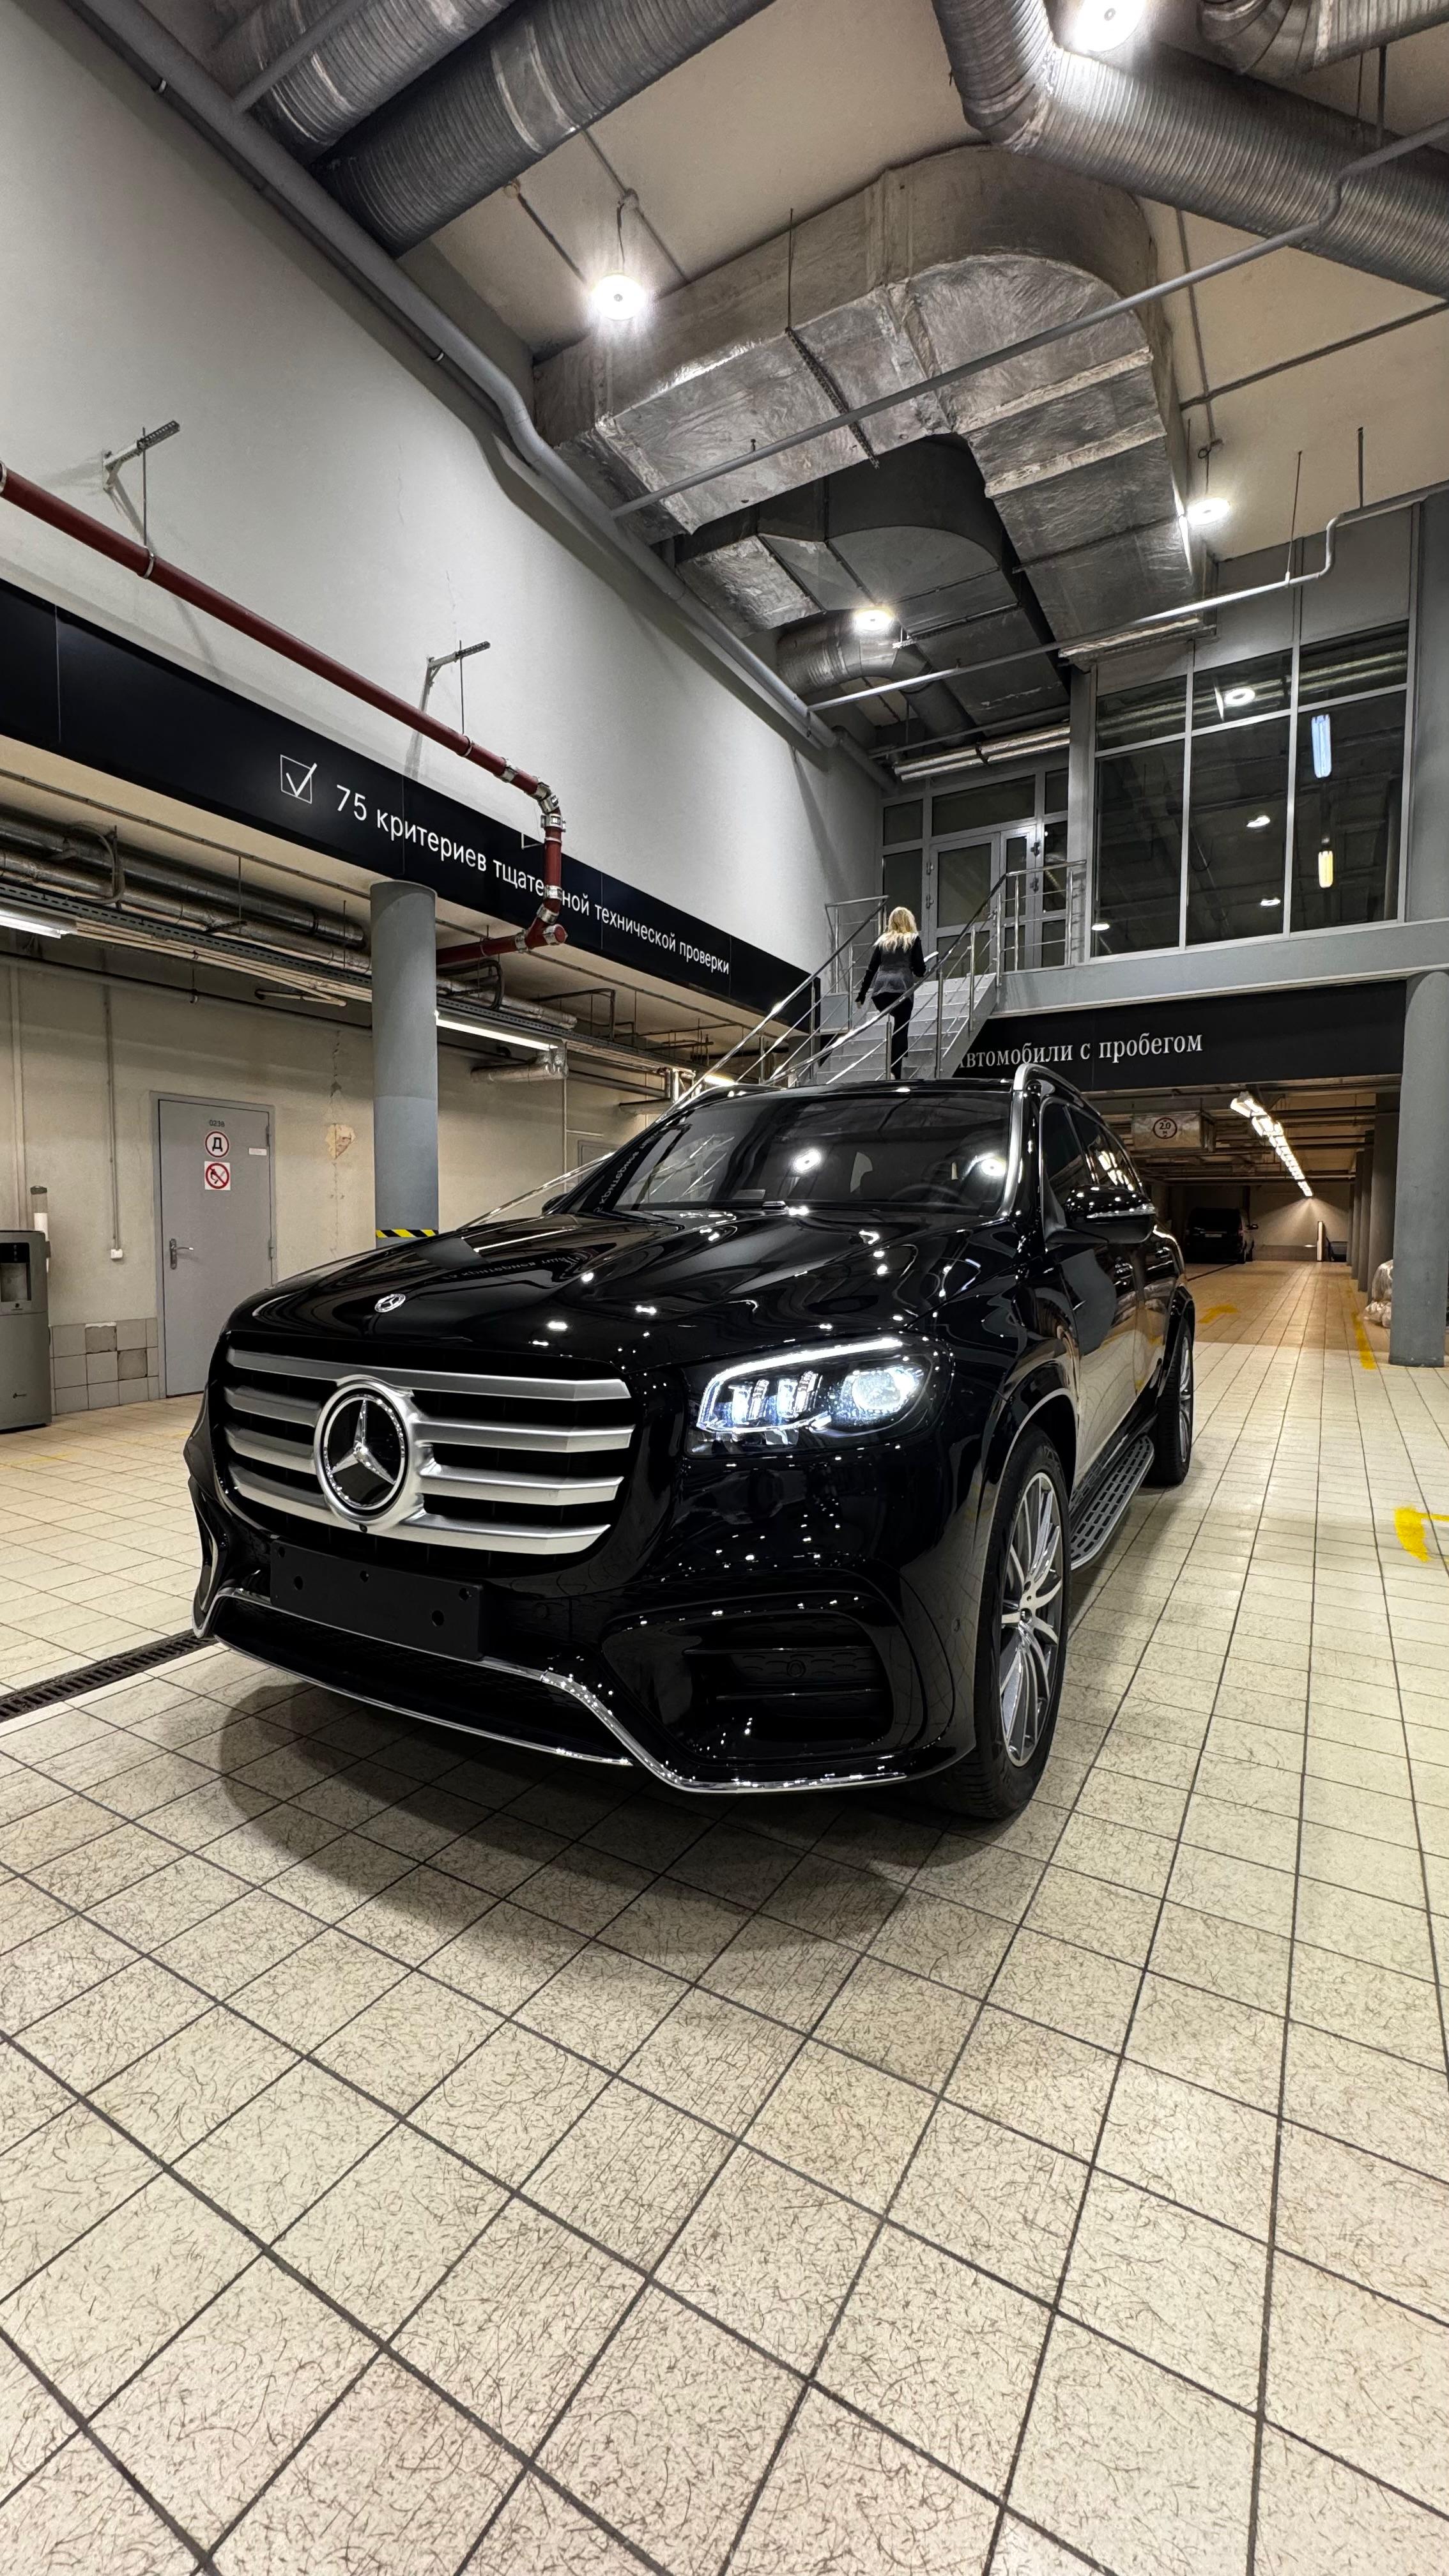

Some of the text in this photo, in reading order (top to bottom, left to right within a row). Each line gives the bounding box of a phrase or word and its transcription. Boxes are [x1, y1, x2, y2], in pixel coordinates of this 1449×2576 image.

[336, 784, 729, 975] 75 критериев тщатеной технической проверки
[1080, 1043, 1091, 1061] с
[1098, 1032, 1203, 1064] пробегом
[212, 1137, 223, 1152] Д
